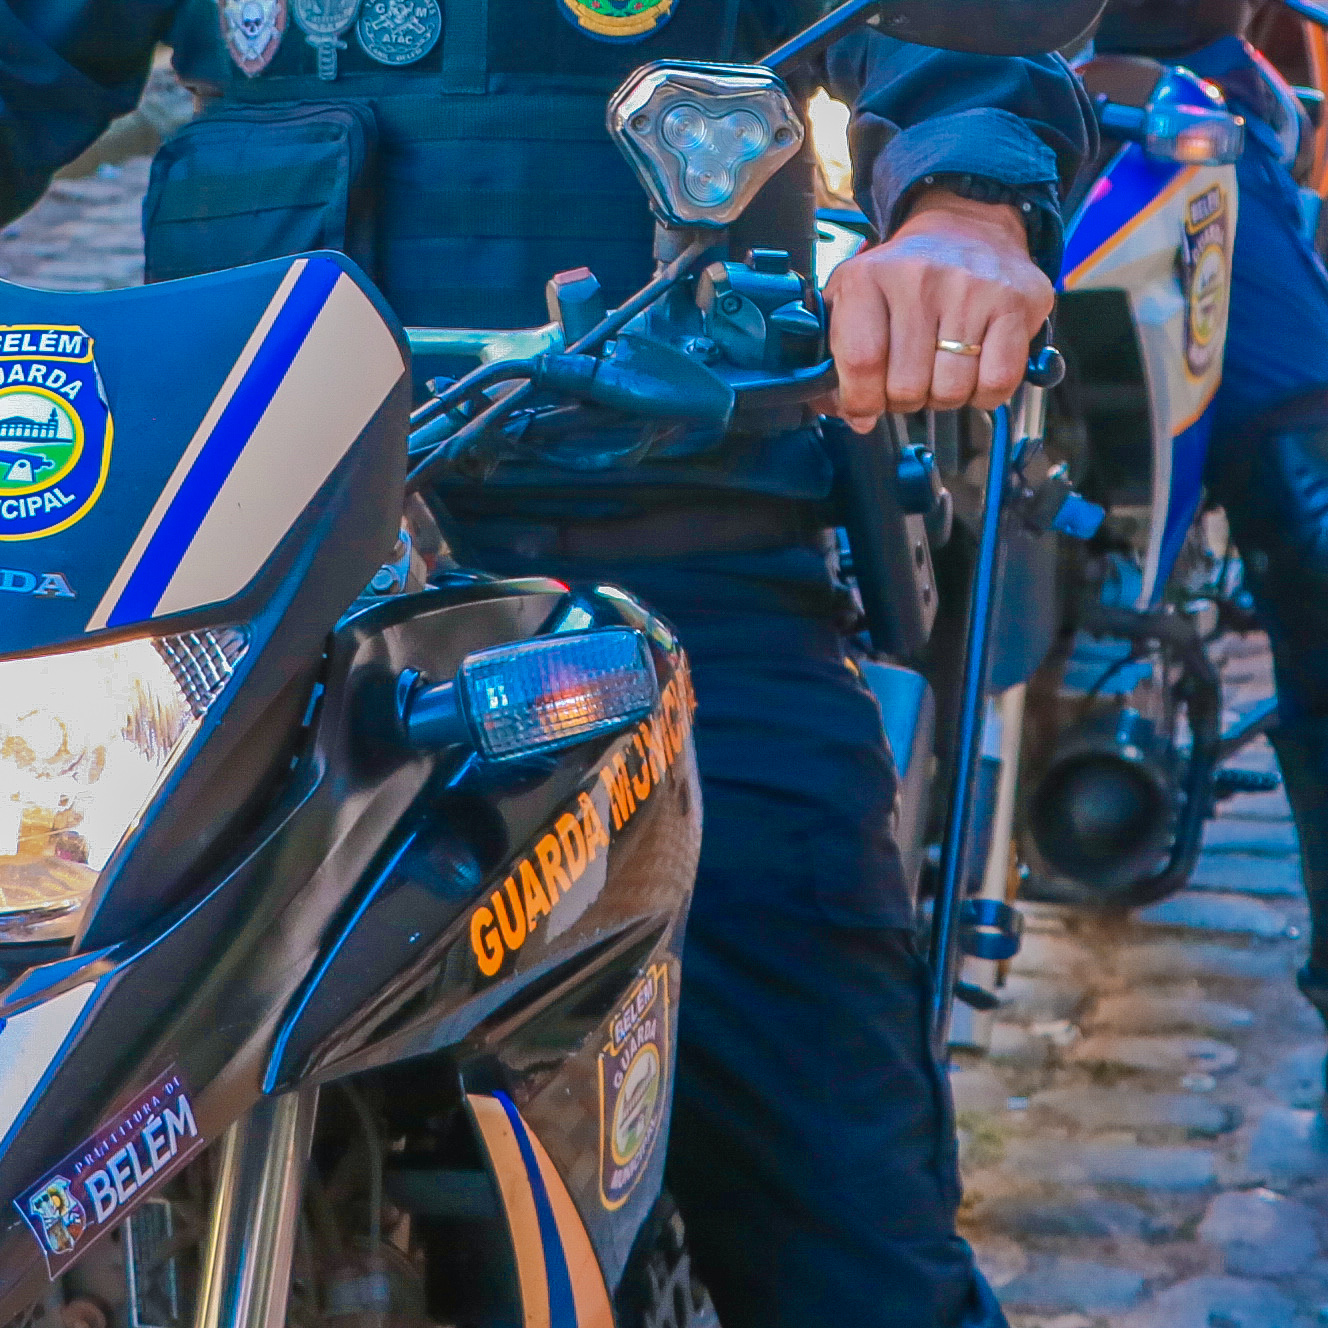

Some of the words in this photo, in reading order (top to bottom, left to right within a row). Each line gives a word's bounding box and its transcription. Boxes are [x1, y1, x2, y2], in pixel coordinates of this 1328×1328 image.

[470, 791, 610, 977] GUARDA
[613, 1018, 658, 1089] GUARDA
[83, 1093, 198, 1224] BELÉM
